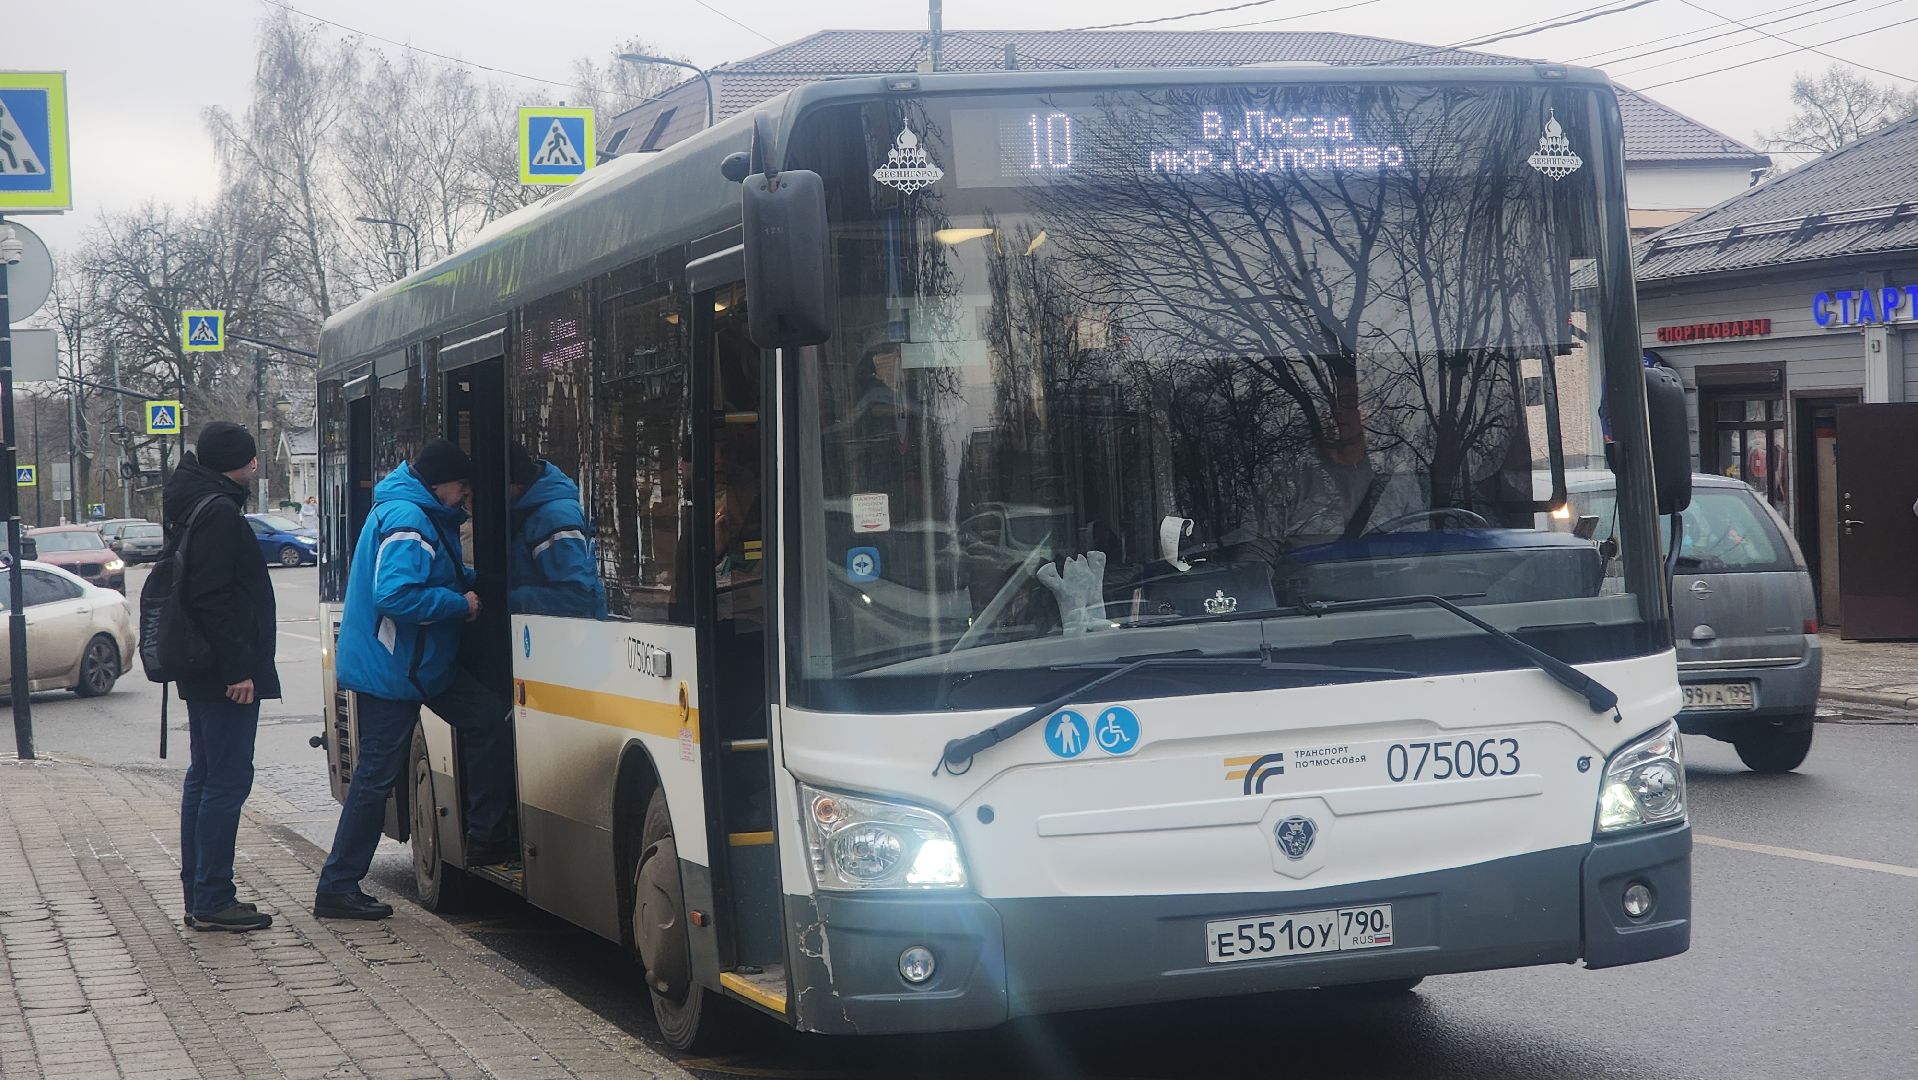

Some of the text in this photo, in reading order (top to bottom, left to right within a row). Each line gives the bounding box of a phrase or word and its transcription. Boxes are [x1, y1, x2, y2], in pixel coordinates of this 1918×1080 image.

[1027, 111, 1072, 169] 10
[1202, 110, 1354, 142] В.Посад
[1150, 141, 1403, 173] мкр.Супонево
[877, 169, 939, 179] ЗВЕНИГОРОД
[1812, 284, 1918, 327] СТАРТ
[1656, 318, 1771, 342] СПОРТТОВАРЫ
[143, 606, 162, 647] PUMA
[1683, 686, 1725, 704] 99УА
[1295, 746, 1349, 758] ТРАНСПОРТ
[1387, 738, 1521, 783] 075063
[1340, 909, 1385, 936] 790
[1352, 934, 1375, 945] RUS
